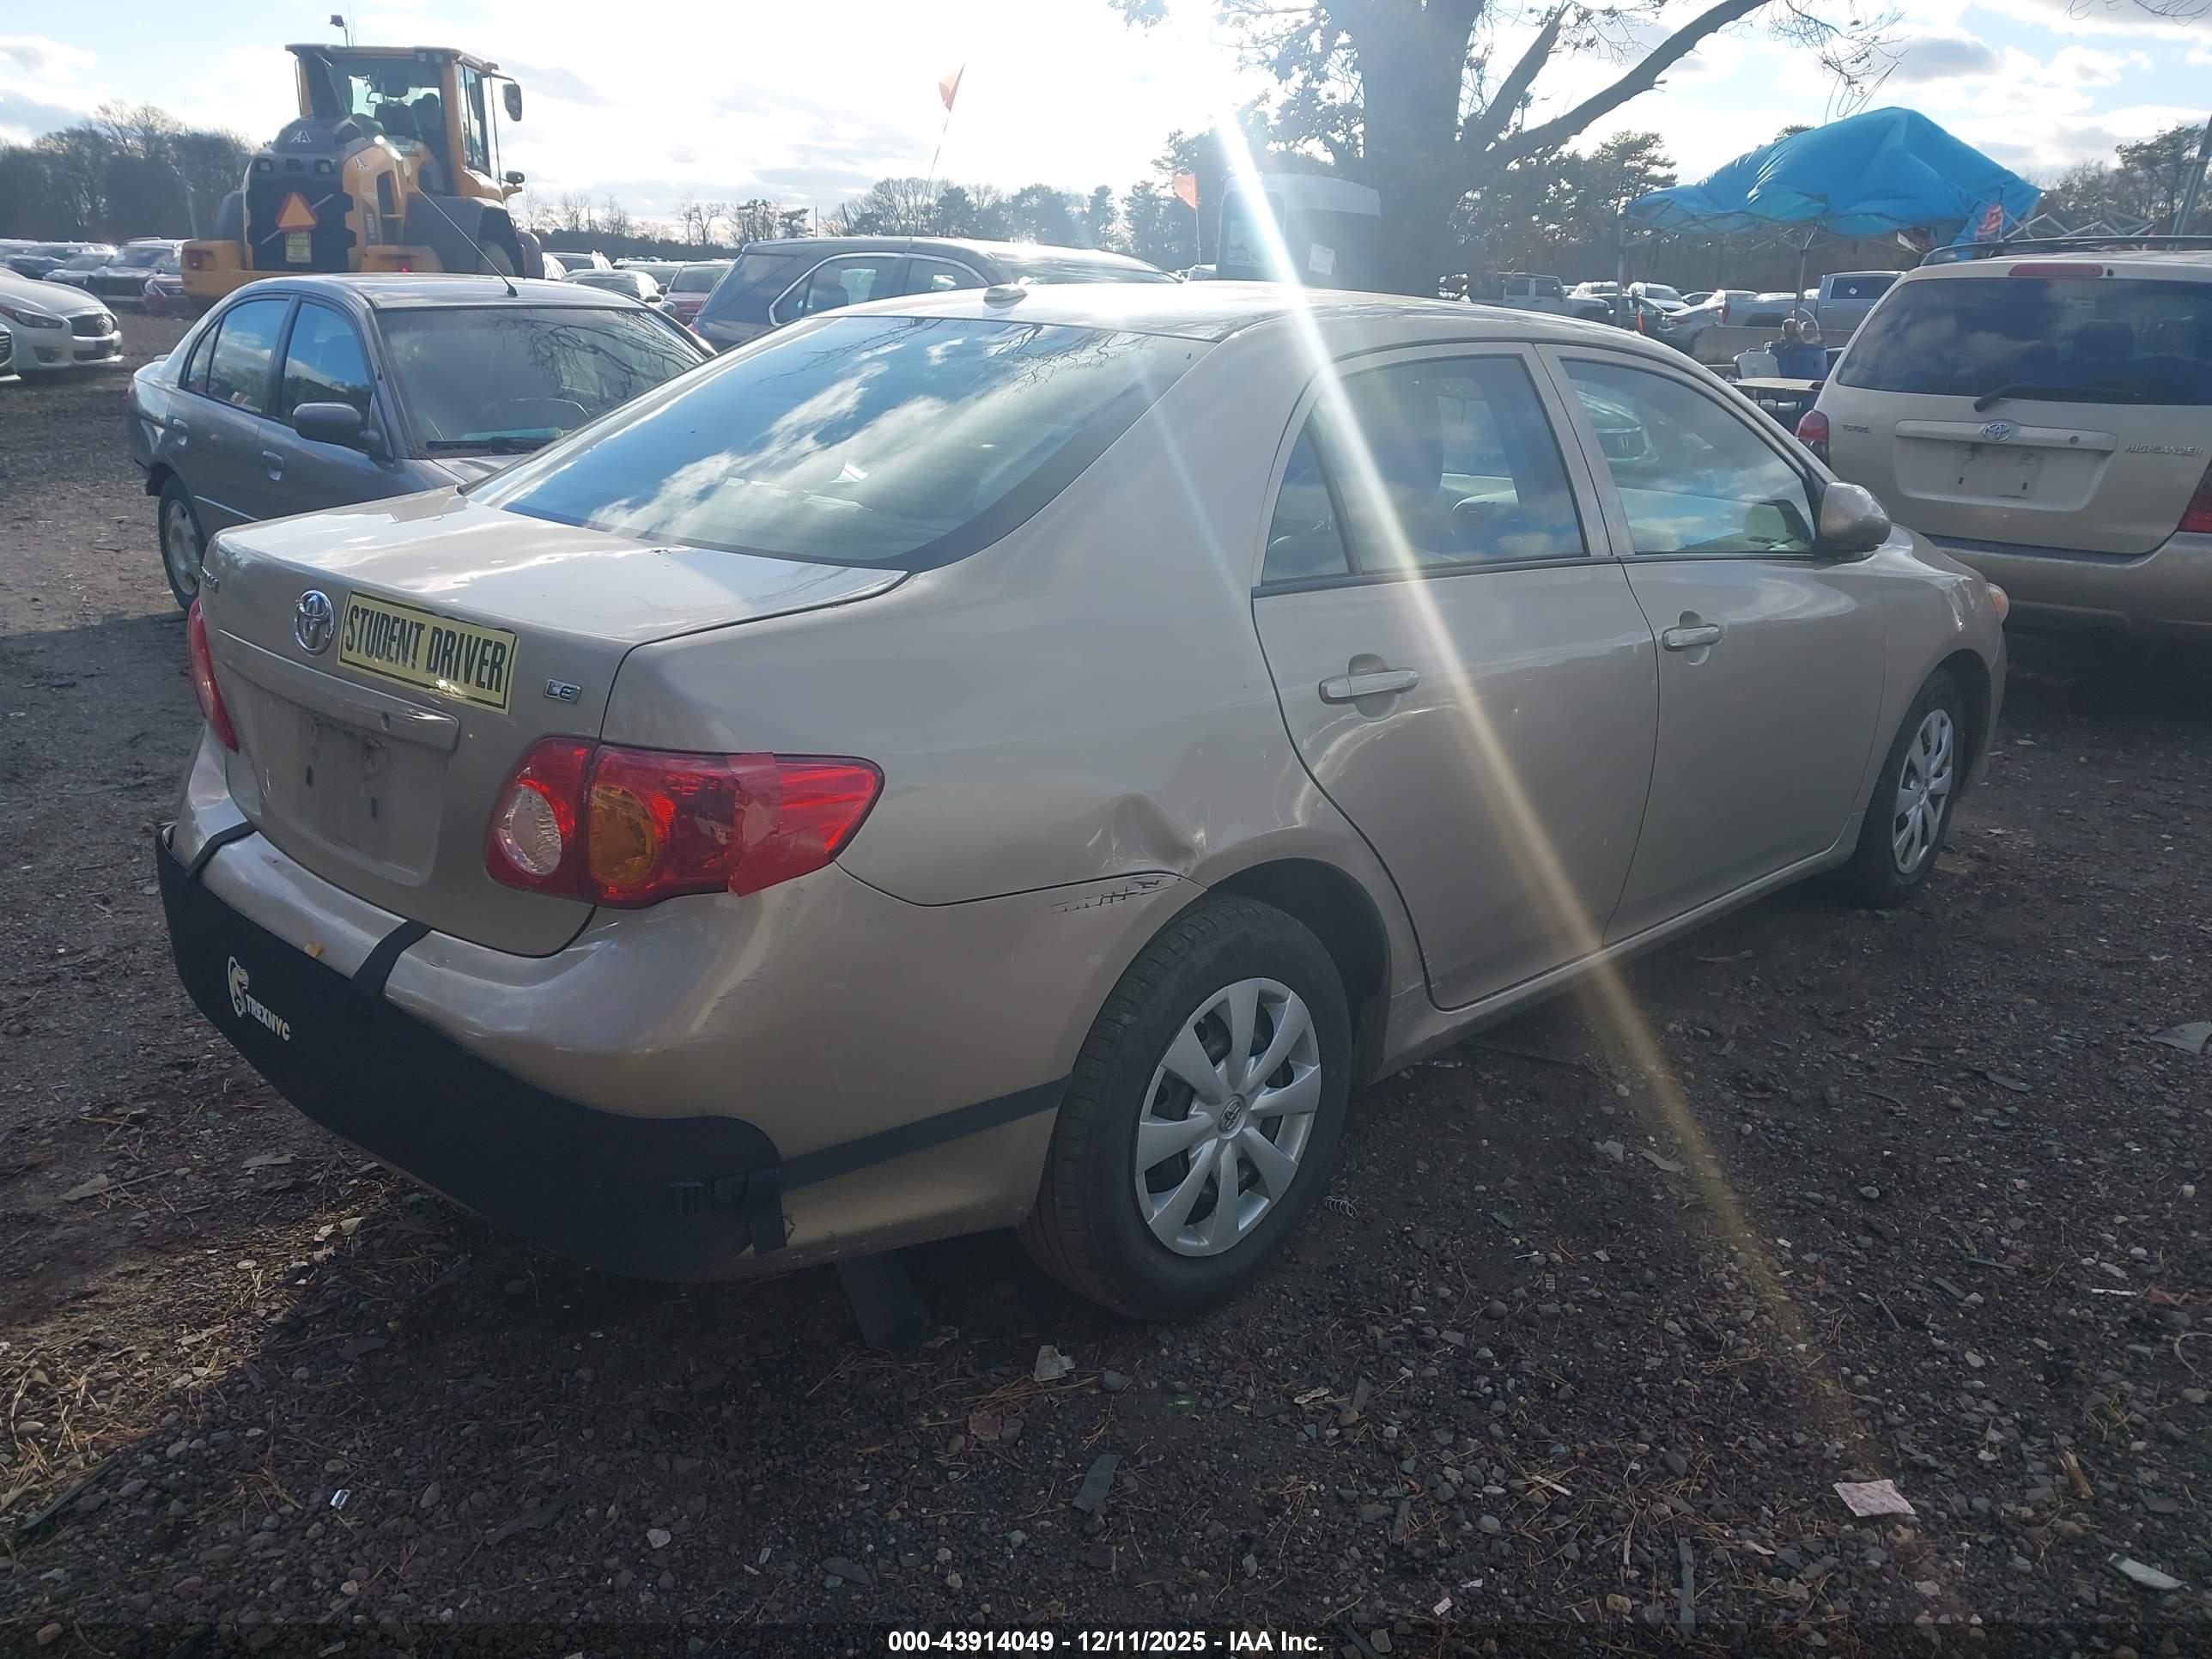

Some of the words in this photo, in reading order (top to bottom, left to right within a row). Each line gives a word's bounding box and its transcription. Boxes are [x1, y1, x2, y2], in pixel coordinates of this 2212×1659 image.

[2125, 442, 2205, 456] HIGHLANDER
[345, 605, 425, 671] STUDENT
[425, 626, 507, 693] DRIVER
[544, 679, 582, 703] LE
